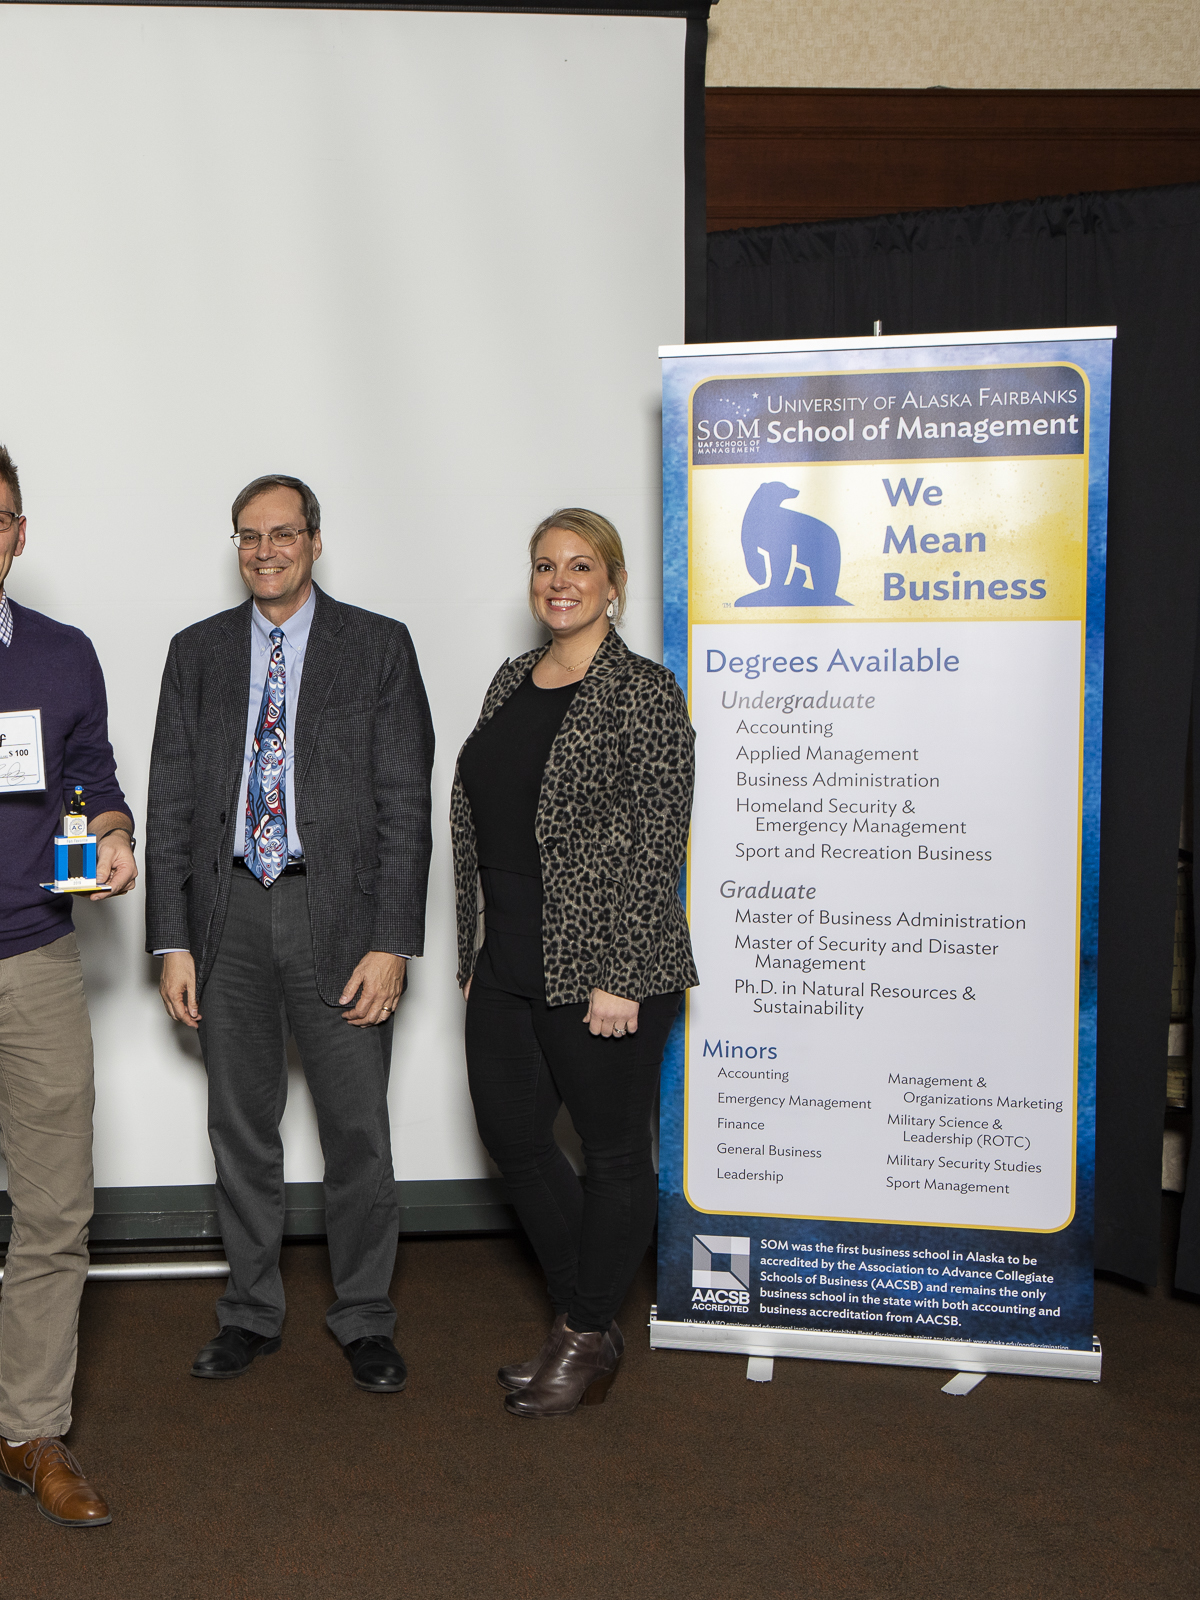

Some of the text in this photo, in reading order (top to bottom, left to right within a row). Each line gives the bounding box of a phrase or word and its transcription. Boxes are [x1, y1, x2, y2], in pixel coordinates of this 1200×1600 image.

[768, 395, 868, 414] UNIVERSITY
[901, 391, 972, 409] ALASKA
[979, 387, 1077, 406] FAIRBANKS
[697, 419, 760, 440] SOM
[767, 414, 1078, 444] School of Management
[698, 446, 760, 454] MANAGEMENT
[882, 477, 943, 507] We
[883, 525, 986, 554] Mean
[884, 571, 1047, 601] Business
[706, 647, 959, 680] Degrees Available
[722, 690, 875, 714] Undergraduate
[736, 719, 833, 738] Accounting
[15, 749, 28, 757] 100
[736, 745, 919, 764] Applied Management
[737, 772, 939, 788] Business Administration
[737, 798, 915, 818] Homeland Security &
[756, 817, 966, 837] Emergency Management
[735, 842, 992, 861] Sport and Recreation Business
[720, 880, 816, 900] Graduate
[735, 909, 1026, 929] Master of Business Administration
[735, 934, 999, 956] Master of Security and Disaster
[755, 954, 866, 973] Management
[735, 979, 976, 1001] Ph.D. in Natural Resources &
[753, 998, 864, 1020] Sustainability
[703, 1039, 777, 1060] Minors
[717, 1067, 789, 1083] Accounting
[718, 1092, 871, 1110] Emergency Management
[717, 1142, 822, 1158] General Business
[717, 1168, 784, 1184] Leadership
[692, 1289, 750, 1304] AACSB
[692, 1304, 749, 1314] ACCREDITED
[760, 1303, 961, 1326] business accreditation from AACSB.
